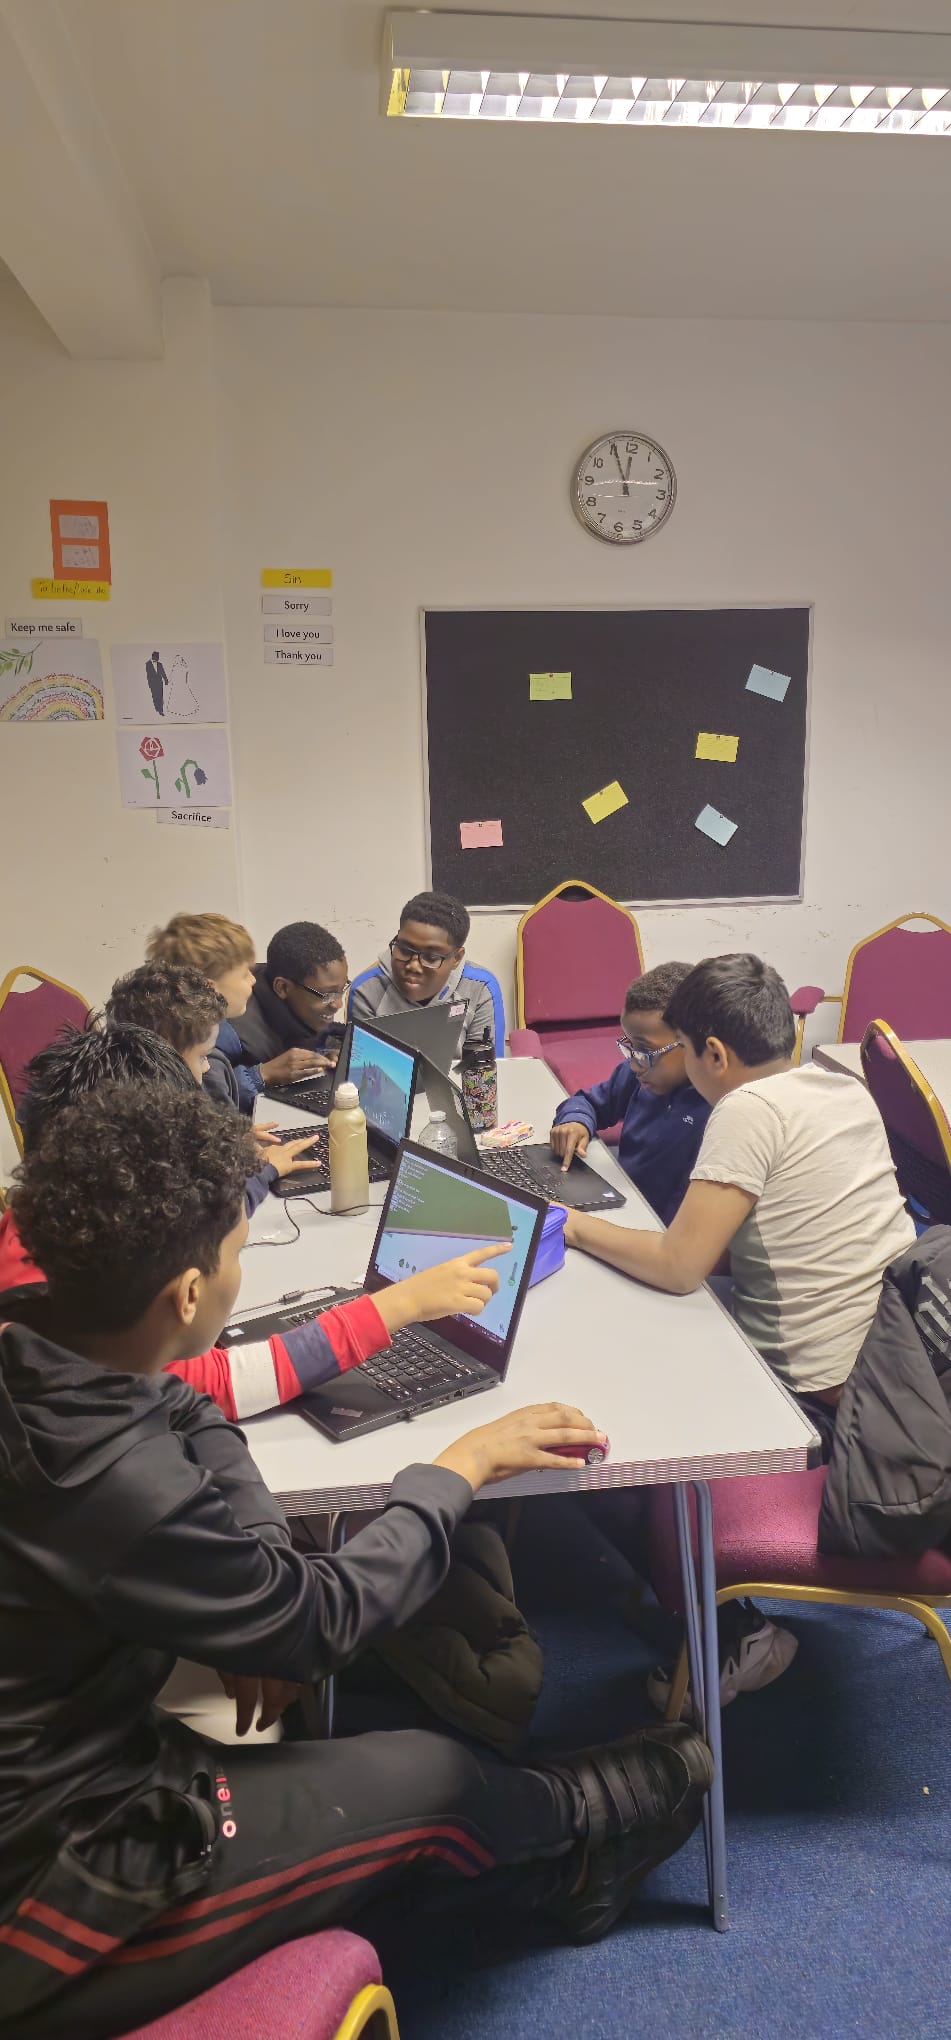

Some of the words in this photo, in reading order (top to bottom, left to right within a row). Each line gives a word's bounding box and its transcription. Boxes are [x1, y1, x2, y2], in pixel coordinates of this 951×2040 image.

[626, 442, 638, 454] 12
[647, 451, 652, 462] 1
[593, 457, 604, 468] 10
[654, 469, 665, 480] 2
[585, 476, 594, 486] 9
[656, 489, 666, 500] 3
[586, 496, 596, 506] 8
[597, 512, 606, 523] 7
[648, 508, 657, 519] 4
[613, 522, 624, 532] 6
[632, 520, 643, 530] 5
[284, 600, 310, 613] Sorry
[10, 622, 36, 635] Keep
[55, 621, 76, 632] safe
[281, 628, 301, 638] love
[302, 631, 320, 641] you
[275, 650, 303, 660] Thank
[304, 652, 322, 662] you
[171, 810, 212, 822] Sacrifice
